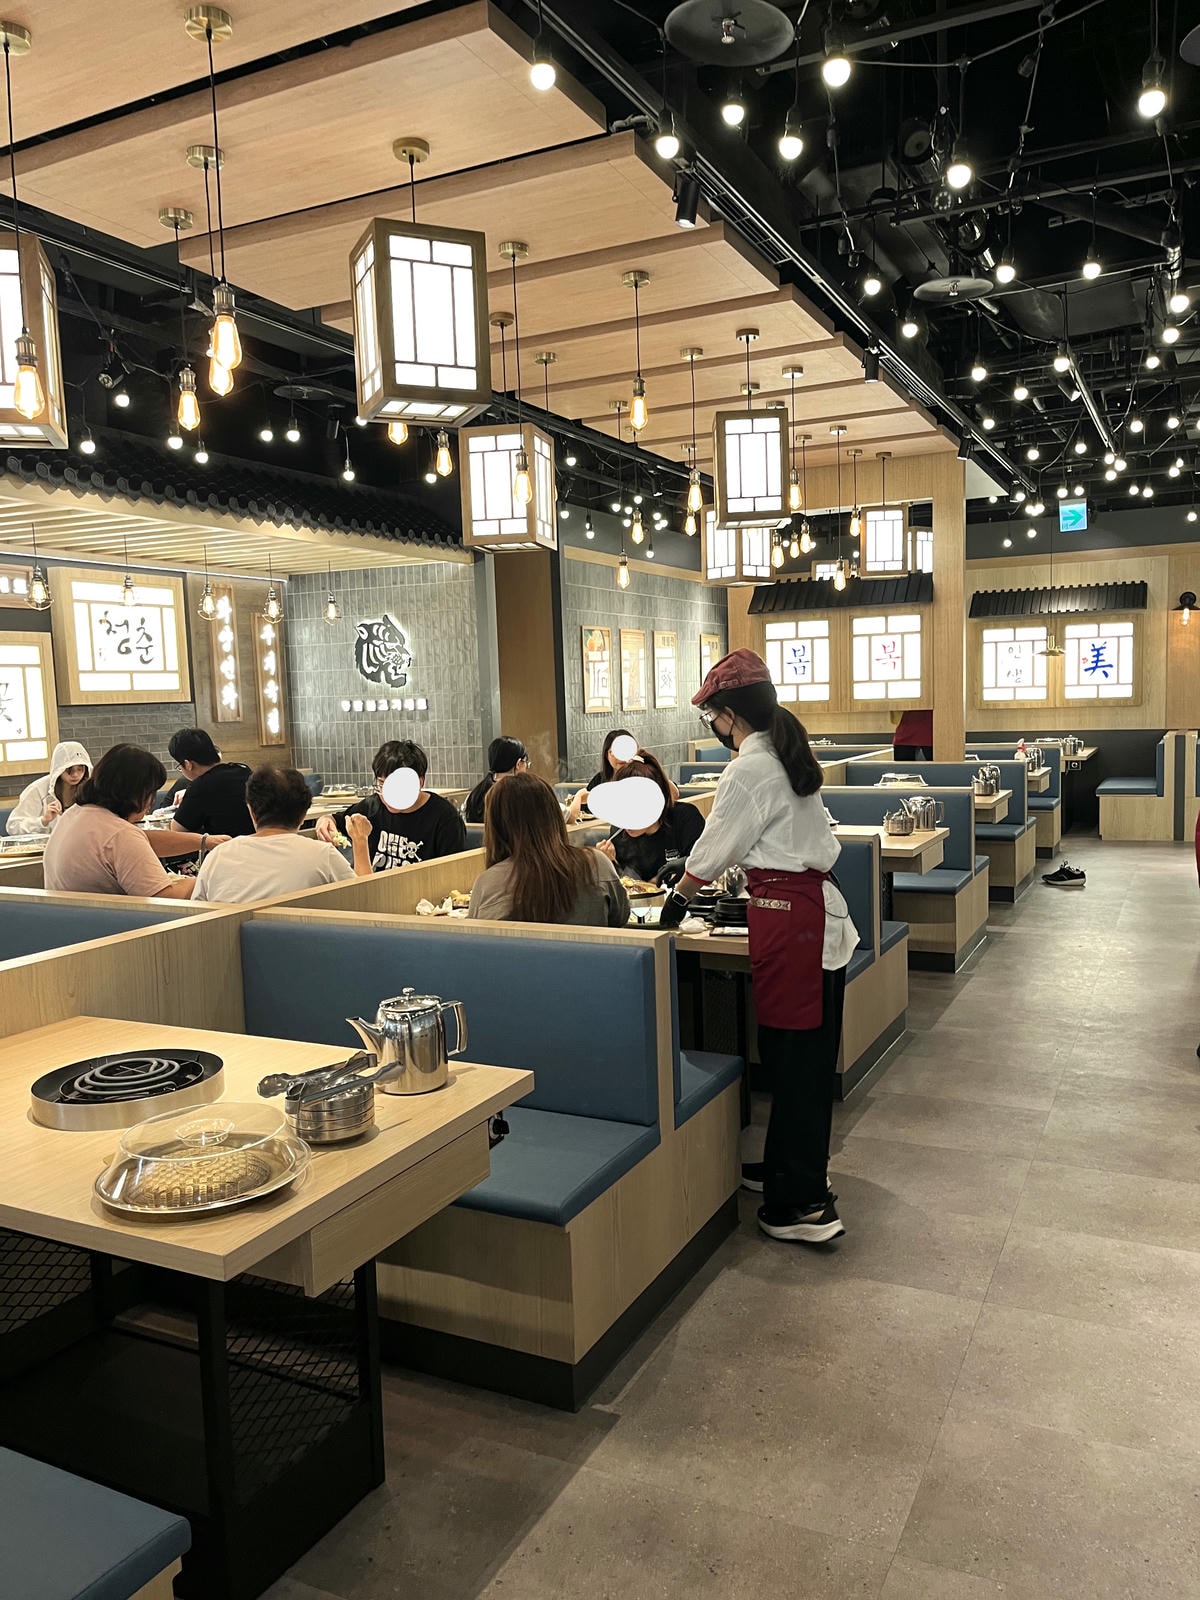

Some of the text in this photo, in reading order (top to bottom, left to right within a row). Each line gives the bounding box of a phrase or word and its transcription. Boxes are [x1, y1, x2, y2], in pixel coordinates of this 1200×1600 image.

[99, 610, 155, 665] 청춘
[786, 644, 811, 676] 봄
[875, 640, 903, 671] 복
[1083, 640, 1114, 679] 美
